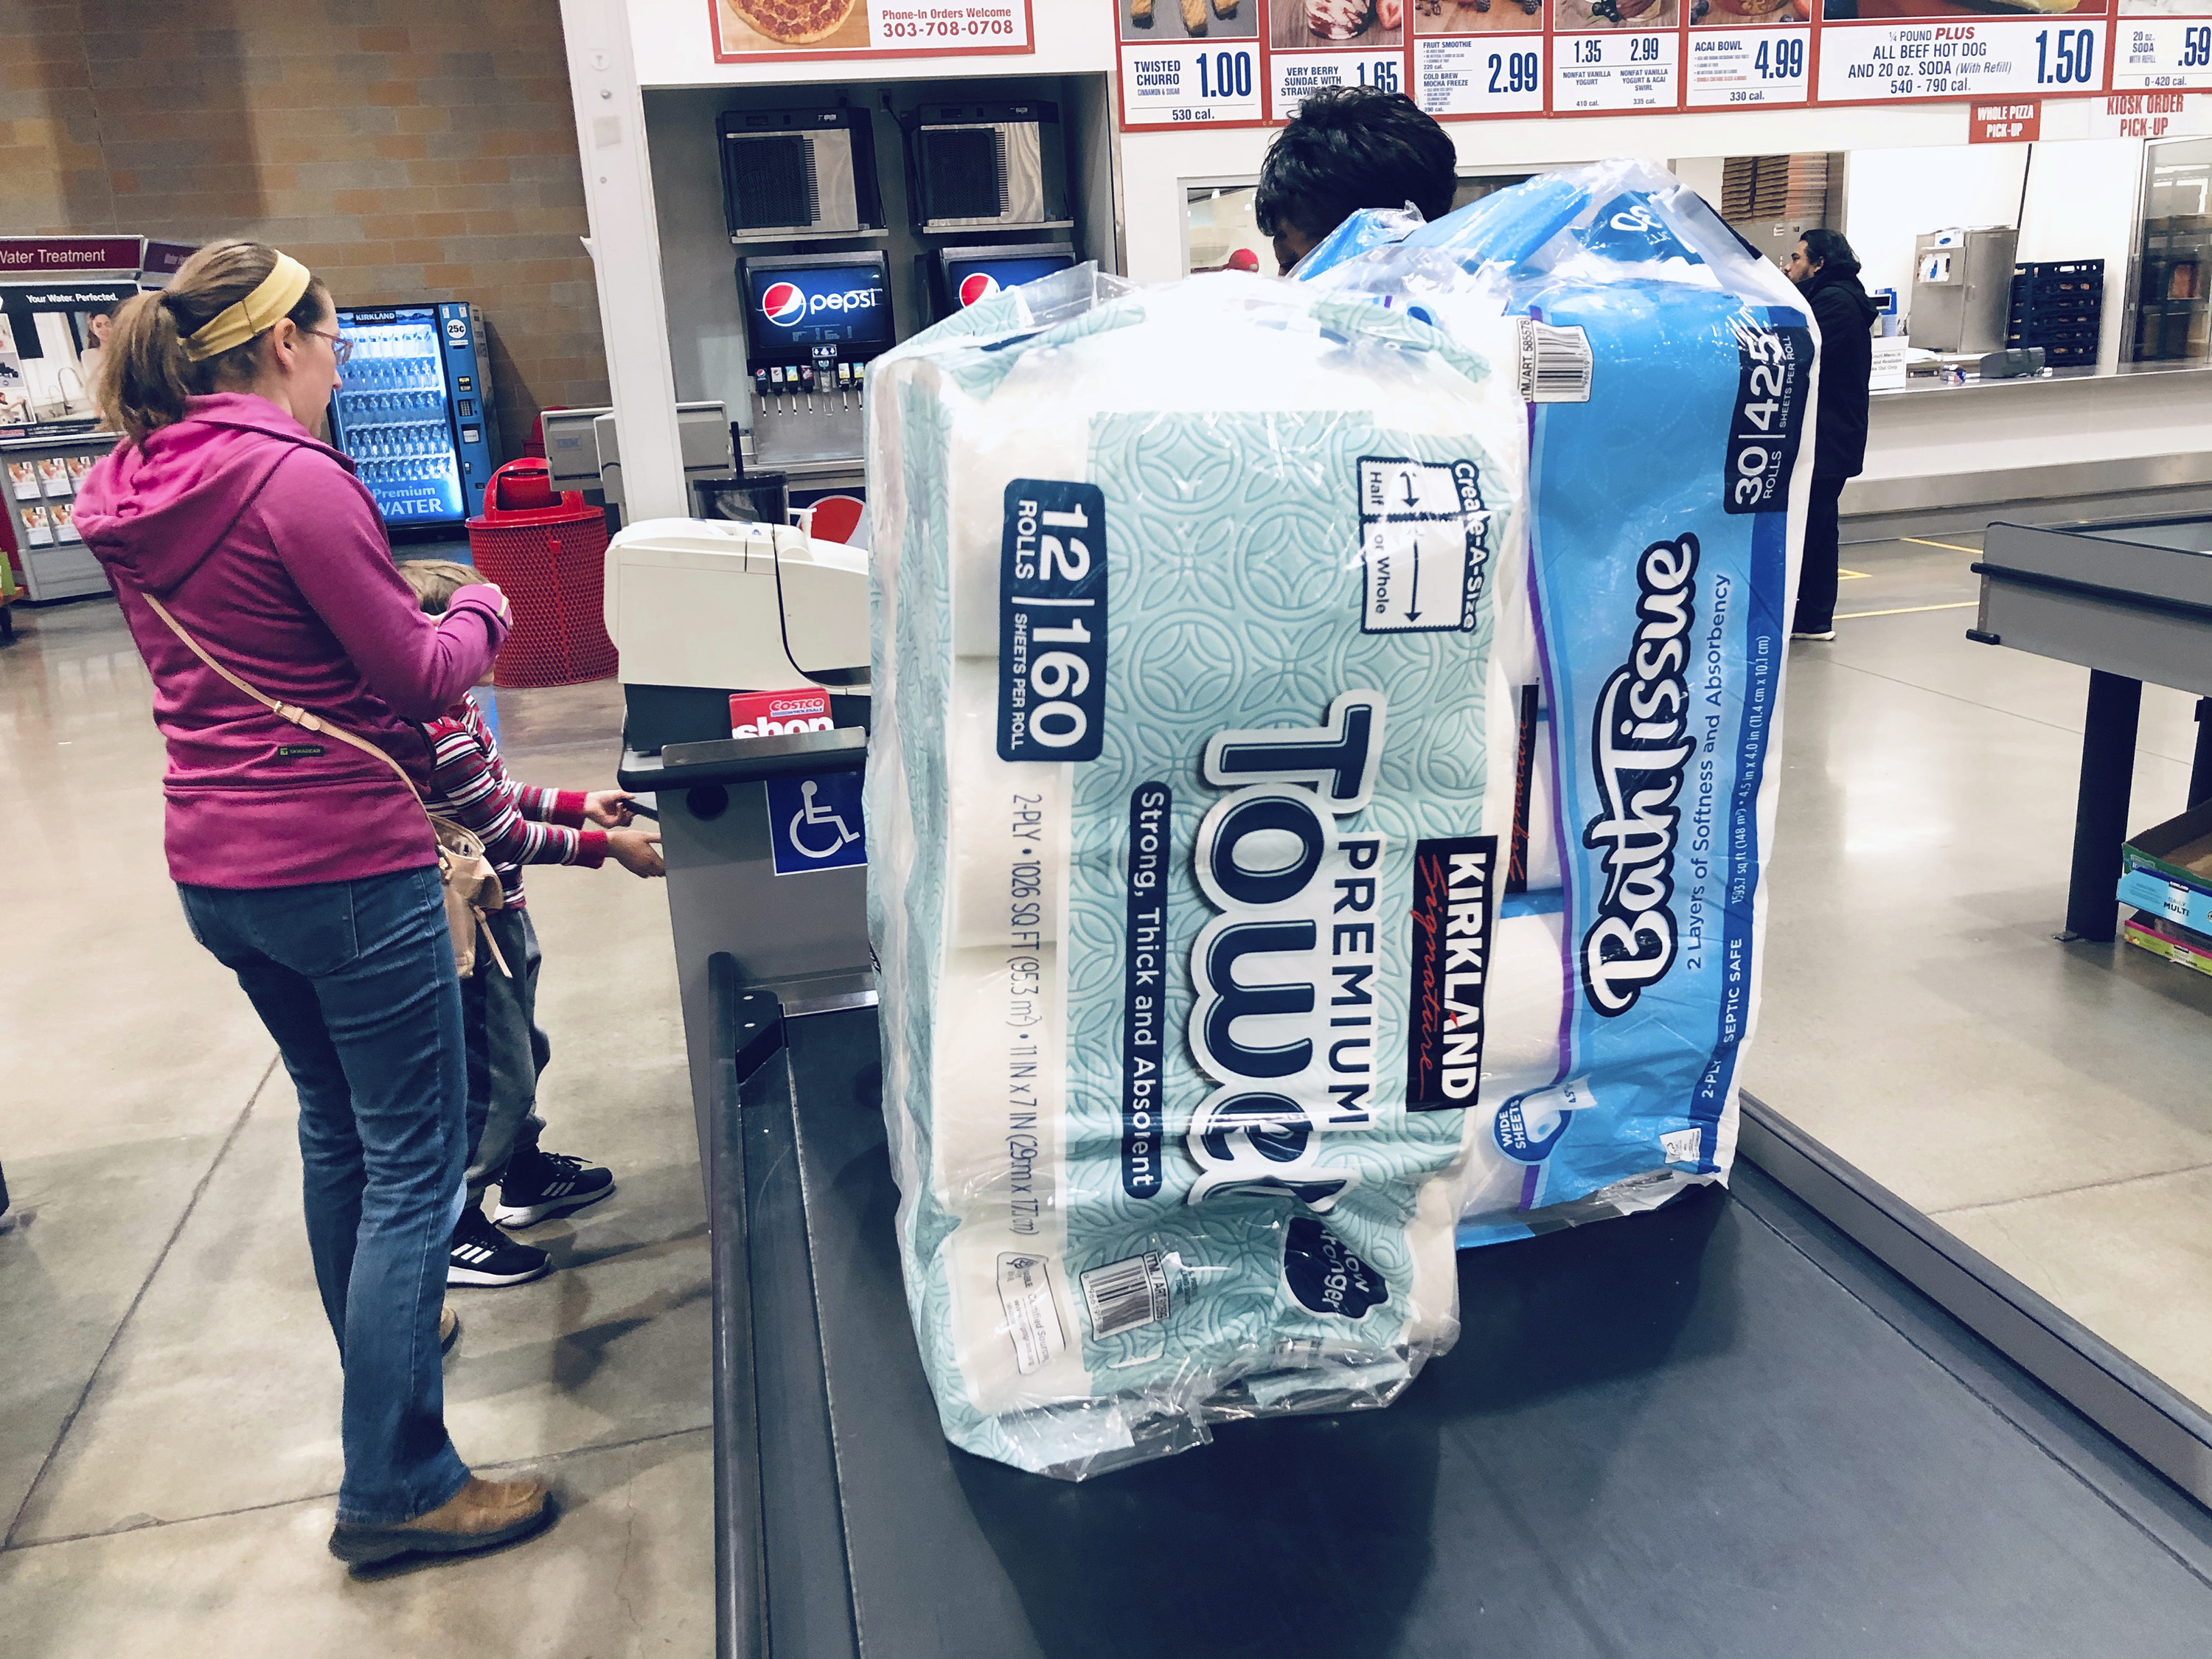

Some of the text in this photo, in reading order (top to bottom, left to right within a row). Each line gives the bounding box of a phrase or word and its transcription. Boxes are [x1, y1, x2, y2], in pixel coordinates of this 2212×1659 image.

[882, 7, 1012, 21] Phone-In Orders Welcome
[883, 20, 1014, 38] 303-708-0708
[1900, 30, 1932, 41] POUND
[1935, 27, 1975, 41] PLUS
[2133, 31, 2143, 41] 20
[1574, 39, 1601, 63] 1.35
[1630, 37, 1660, 61] 2.99
[1694, 41, 1743, 52] ACAI BOWL
[1873, 42, 1987, 60] ALL BEEF HOT DOG
[2132, 43, 2154, 52] SODA
[2177, 26, 2211, 66] .59
[1134, 60, 1180, 72] TWISTED
[1754, 38, 1804, 79] 4.99
[2036, 29, 2095, 84] 1.50
[1196, 52, 1251, 98] 1.00
[1287, 66, 1338, 76] VERY BERRY
[1489, 52, 1539, 94] 2.99
[1848, 60, 2012, 79] AND 20 oz. SODA (With Refill)
[1137, 73, 1180, 86] CHURRO
[1284, 76, 1341, 86] SUNDAE WITH
[1891, 80, 1913, 94] 540
[1925, 78, 1947, 92] 790
[1951, 77, 1971, 91] cal.
[2172, 75, 2187, 86] cal.
[1730, 90, 1765, 101] 330 cal.
[2107, 94, 2184, 115] KIOSK ORDER
[1172, 108, 1215, 121] 530 cal.
[1977, 104, 2034, 122] WHOLE PIZZA
[1986, 123, 2023, 138] PICK-UP
[2120, 117, 2168, 136] PICK-UP
[37, 248, 106, 263] Treatment
[26, 292, 119, 304] Your Water. Perfected.
[810, 288, 877, 315] pepsi
[355, 313, 395, 321] KIRKLAND
[448, 325, 465, 333] 25¢
[1520, 319, 1532, 352] 585578
[1778, 335, 1795, 428] SHEETS PER ROLL
[1735, 446, 1768, 506] 30
[1763, 451, 1783, 499] ROLLS
[372, 486, 436, 498] Premium
[1370, 471, 1385, 506] Half
[1015, 500, 1038, 580] ROLLS
[1374, 534, 1391, 614] or Whole
[1029, 503, 1091, 748] 12 160
[1756, 635, 1771, 655] cm)
[1756, 657, 1768, 677] 10.1
[1011, 613, 1028, 751] SHEETS PER ROLL
[1755, 686, 1765, 703] cm
[770, 698, 825, 713] COSTCO
[787, 708, 824, 716] WHOLESALE
[1749, 705, 1764, 728] (11.4
[1747, 728, 1759, 740] in
[1745, 741, 1759, 759] 4.0
[1588, 542, 1693, 1009] Bath Tissue
[1688, 574, 1731, 970] 2 Layers of Softness and Absorbency
[1742, 768, 1753, 781] in
[1739, 780, 1751, 799] 4.5
[1012, 793, 1043, 841] 2-PLY
[1134, 791, 1165, 898] Strong,
[1735, 826, 1747, 849] (148
[1736, 860, 1748, 875] sq
[1012, 860, 1042, 898] 1026
[1732, 877, 1745, 905] 1593.7
[1011, 902, 1040, 927] SQ
[2163, 901, 2191, 917] MULTI
[1011, 931, 1040, 950] FT
[1135, 906, 1161, 987] Thick
[1006, 956, 1040, 995] (95.3
[1329, 838, 1381, 1125] PREMIUM
[1411, 855, 1447, 1101] Signature
[1441, 852, 1487, 1099] KIRKLAND
[1134, 996, 1159, 1046] and
[1702, 938, 1742, 1099] 2-PLY SEPTIC SAFE
[1009, 1044, 1037, 1056] 11
[1009, 1062, 1037, 1078] IN
[1009, 1084, 1031, 1094] x
[1009, 1098, 1037, 1107] 7
[1009, 1112, 1037, 1130] IN
[1500, 1111, 1512, 1147] WIDE
[1511, 1099, 1526, 1150] SHEETS
[1011, 1184, 1032, 1193] x
